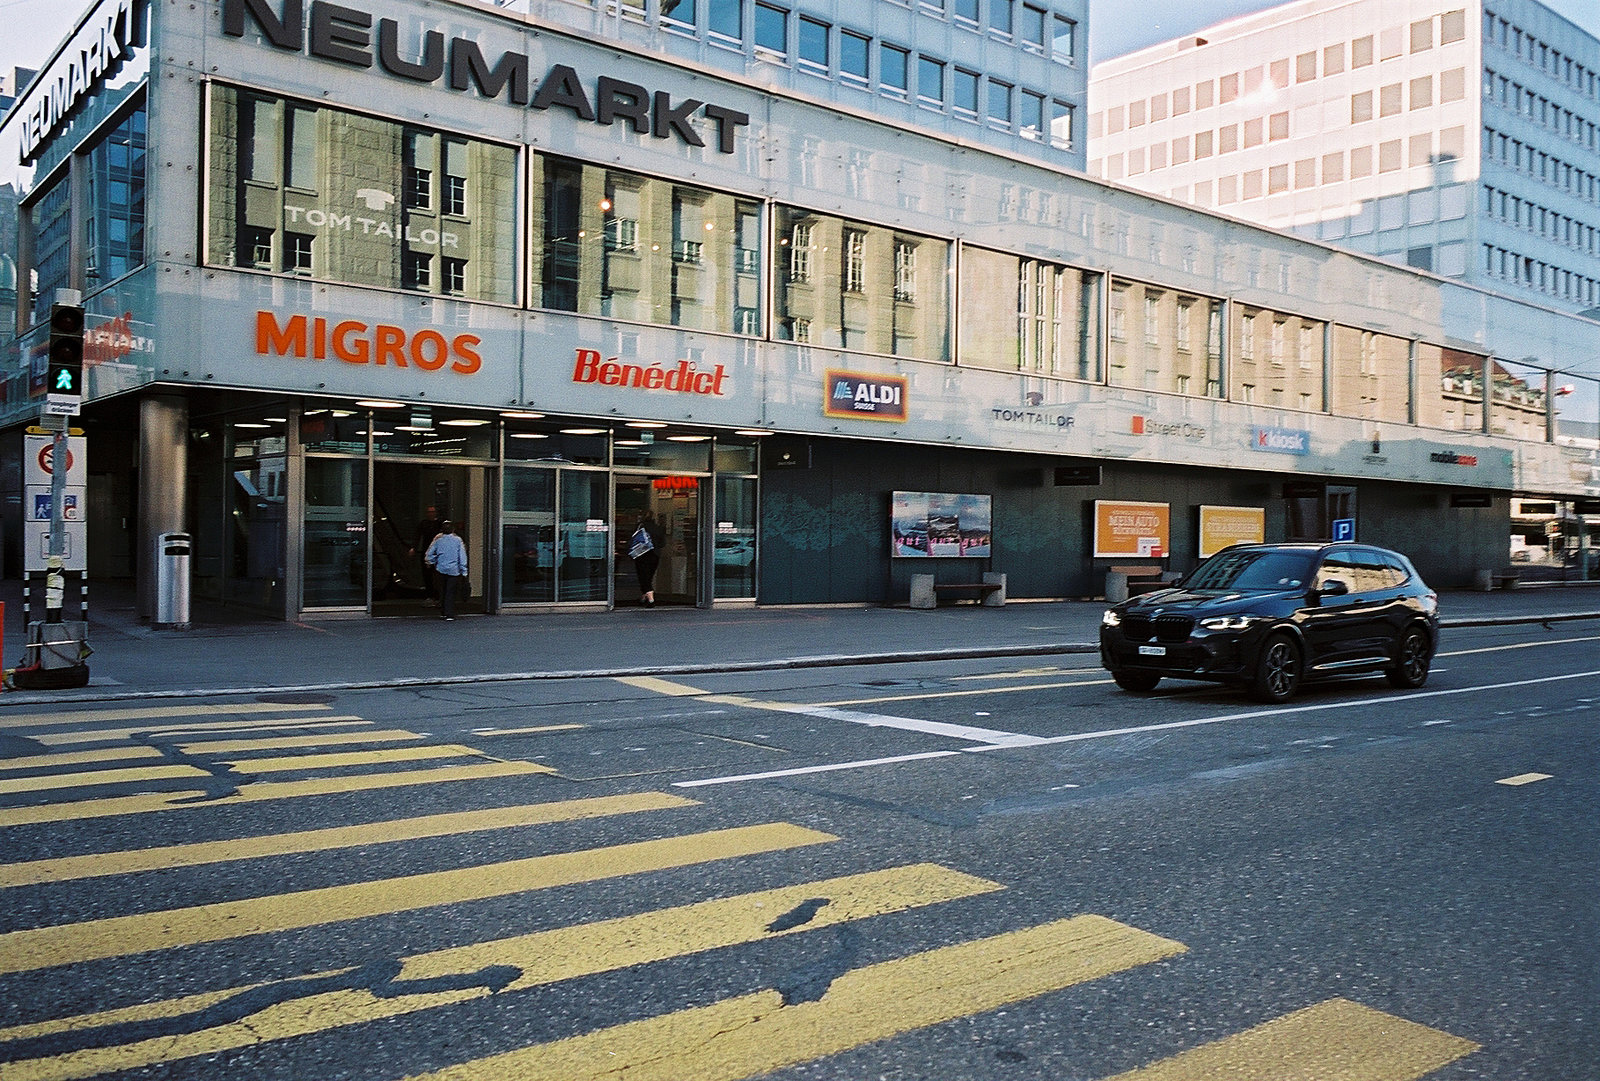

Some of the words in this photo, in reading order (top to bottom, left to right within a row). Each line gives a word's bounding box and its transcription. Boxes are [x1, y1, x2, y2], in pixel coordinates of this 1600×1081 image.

[19, 0, 149, 166] NEUMARKT
[222, 0, 750, 155] NEUMARKT
[284, 204, 352, 232] TOM
[356, 217, 459, 249] TAILOR
[255, 310, 483, 375] MIGROS
[572, 348, 730, 396] Bénédict
[854, 383, 901, 405] ALDI
[992, 408, 1024, 423] TOM
[1026, 412, 1075, 428] TAILOR
[1145, 418, 1183, 437] Street
[1183, 422, 1206, 439] One
[1268, 430, 1304, 450] kiosk
[1338, 523, 1349, 539] P
